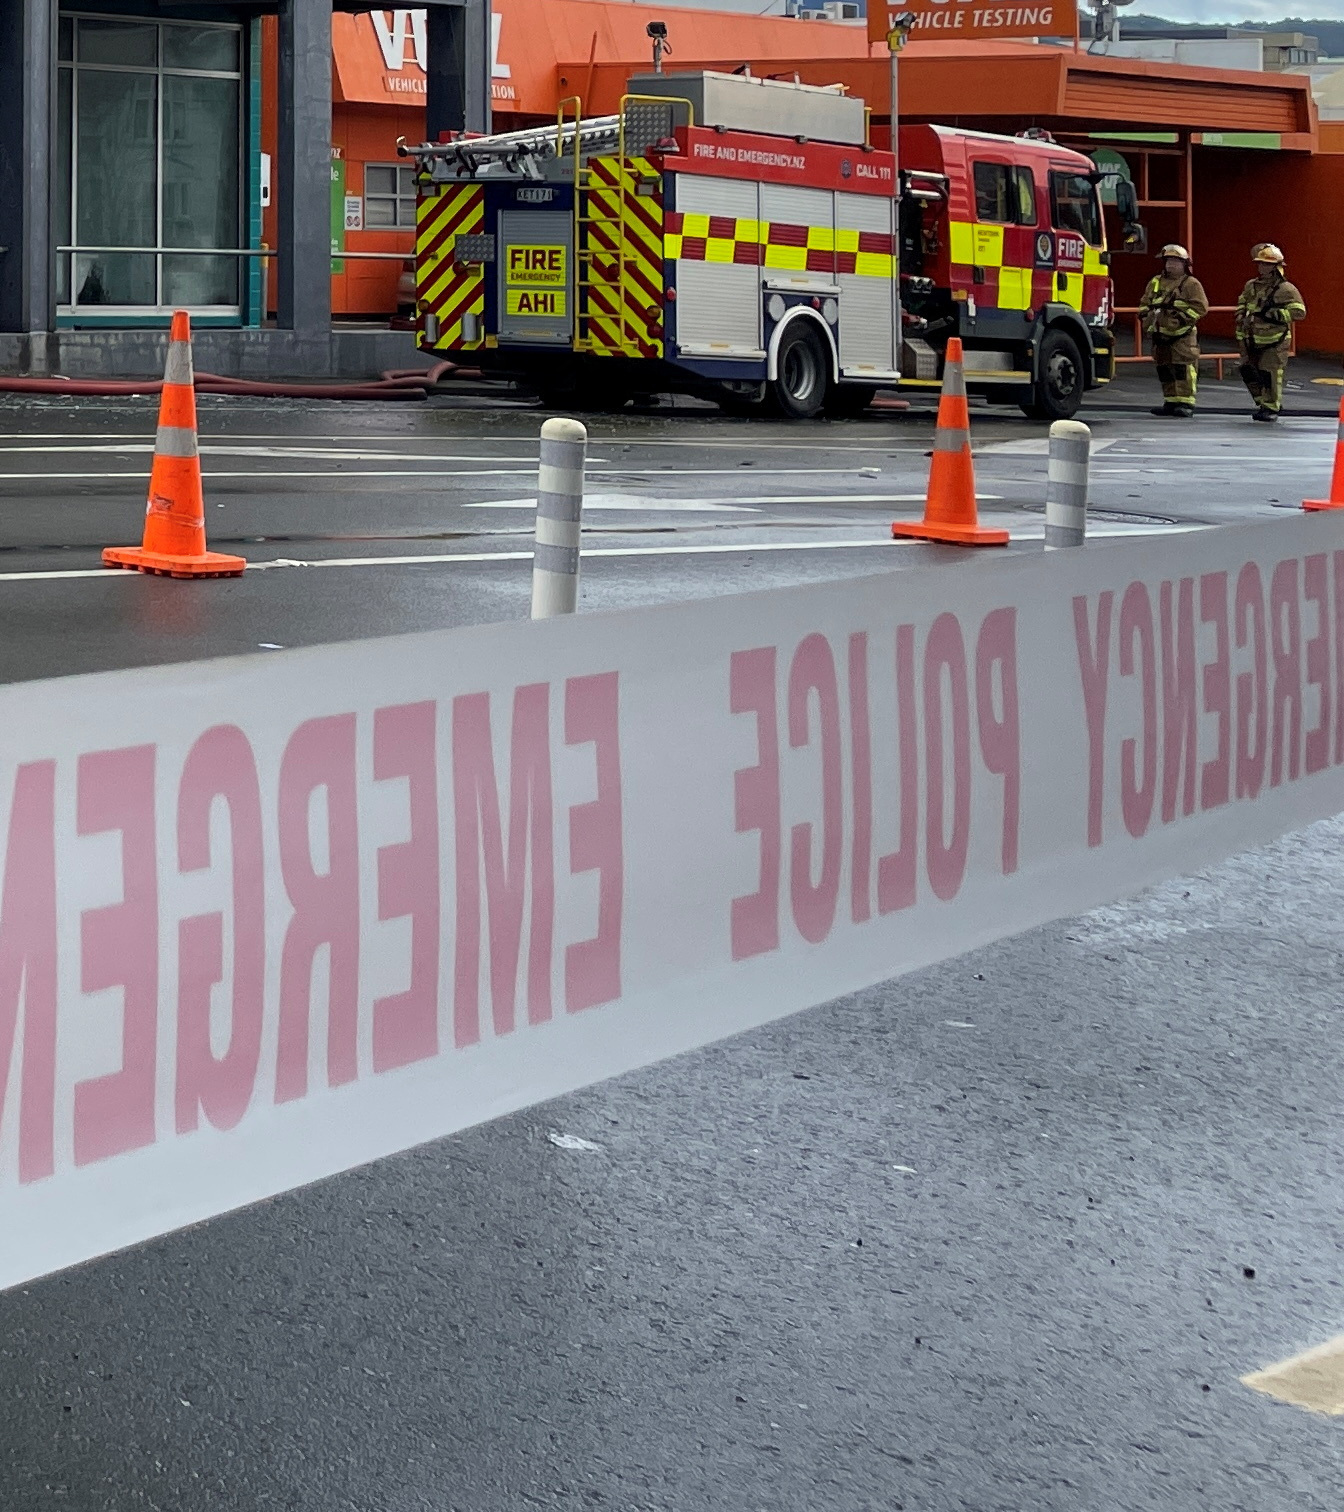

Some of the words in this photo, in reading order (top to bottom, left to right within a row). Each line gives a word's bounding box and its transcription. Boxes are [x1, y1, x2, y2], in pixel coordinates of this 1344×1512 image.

[888, 10, 966, 30] VHICLE
[972, 6, 1054, 28] TESTING
[693, 143, 715, 159] FIRE
[716, 146, 736, 161] AND
[855, 162, 879, 179] CALL
[879, 166, 892, 181] 111
[1058, 238, 1085, 259] FIRE
[511, 248, 562, 271] FIRE
[510, 271, 561, 282] EMERGENCY
[517, 292, 556, 314] AHI
